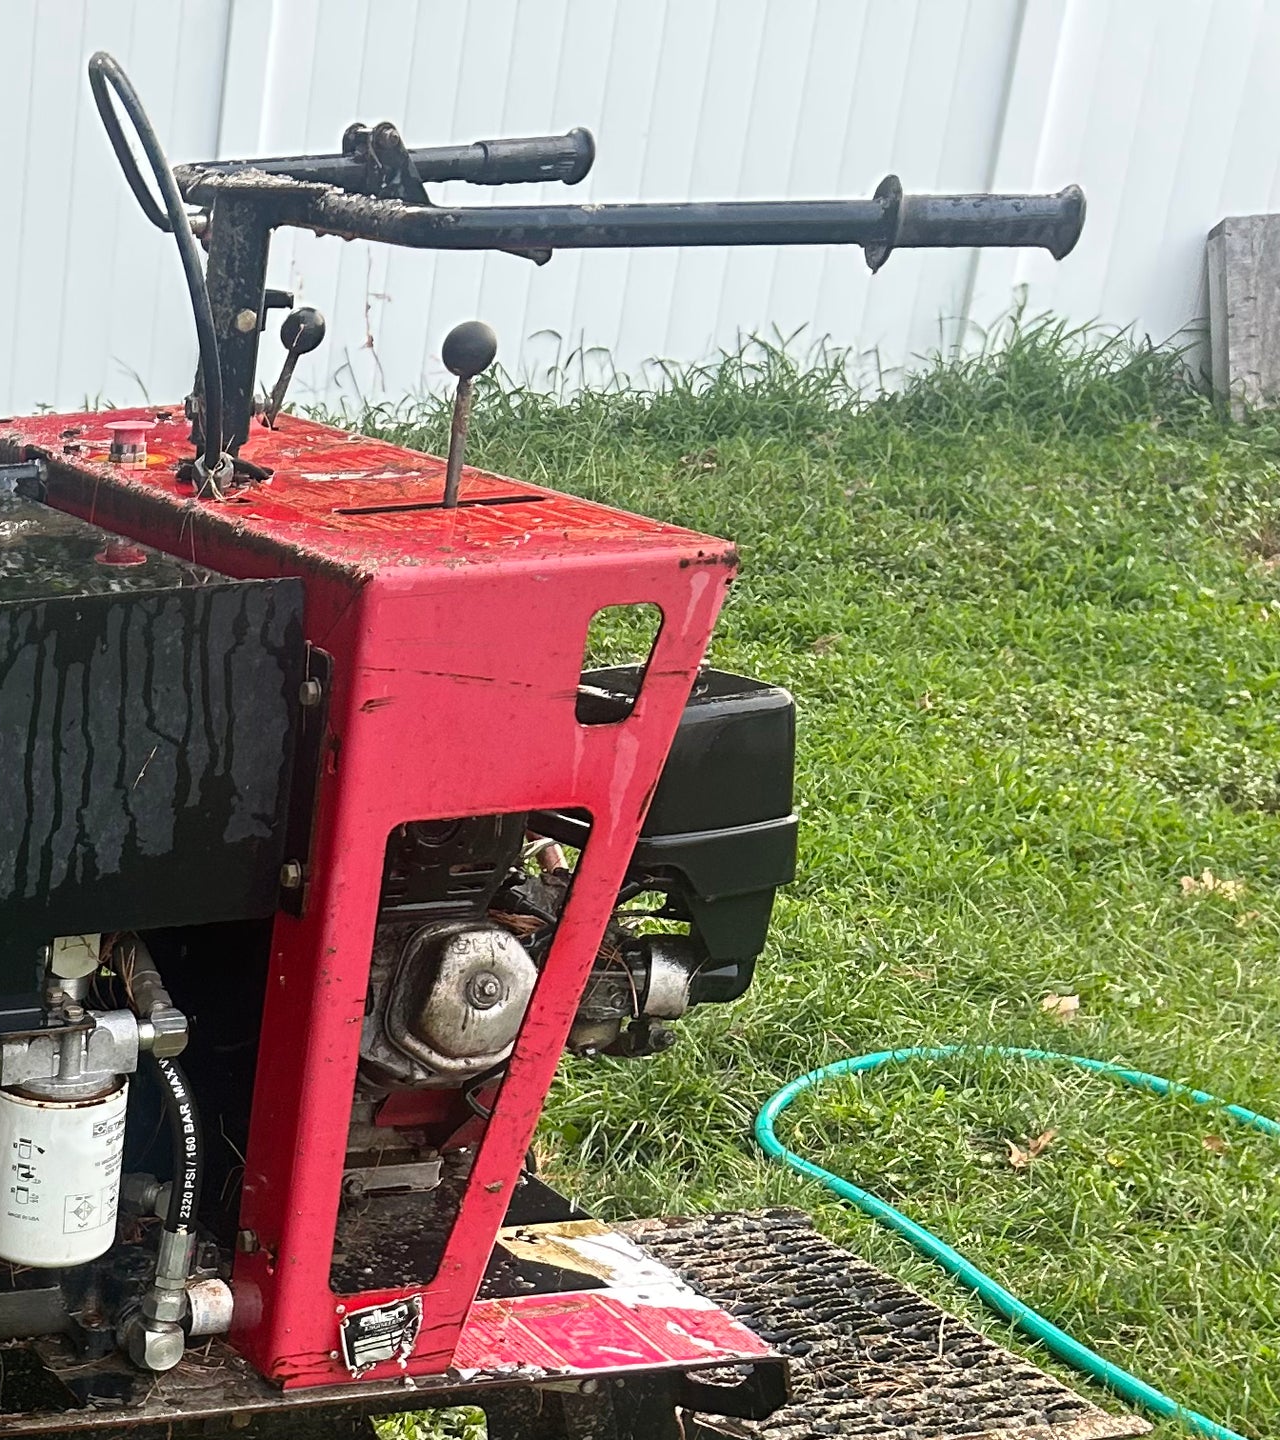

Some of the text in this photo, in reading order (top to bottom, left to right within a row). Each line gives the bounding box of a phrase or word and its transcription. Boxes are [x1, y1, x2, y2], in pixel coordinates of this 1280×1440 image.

[164, 1067, 186, 1098] MAX
[178, 1103, 195, 1134] BAR
[186, 1137, 197, 1158] 160
[184, 1168, 197, 1188] PSI
[179, 1192, 194, 1218] 2320
